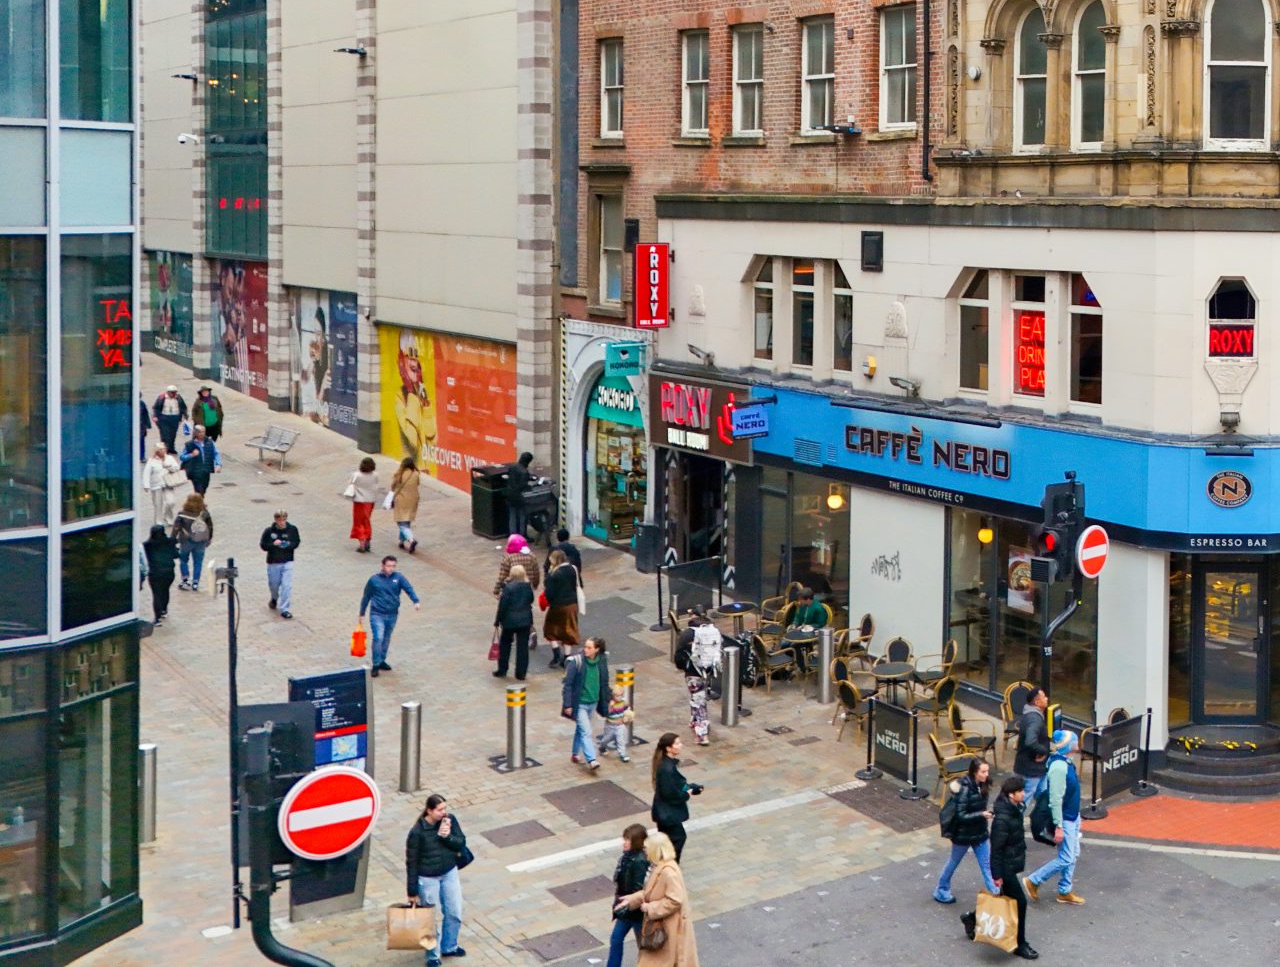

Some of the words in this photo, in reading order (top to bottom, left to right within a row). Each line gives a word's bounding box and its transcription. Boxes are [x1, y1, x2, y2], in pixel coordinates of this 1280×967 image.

[650, 253, 659, 318] ROXY
[1020, 316, 1045, 341] EA
[1210, 329, 1254, 353] ROXY
[609, 361, 639, 371] KOKORO
[598, 385, 635, 412] KOKORO
[661, 381, 712, 430] ROXY
[736, 420, 766, 431] NERO
[421, 443, 462, 471] DISCOVER
[933, 440, 1011, 480] NERO
[889, 480, 900, 490] THE
[902, 483, 926, 496] ITALIAN
[928, 488, 952, 501] COFFEE
[1221, 481, 1238, 496] N
[1190, 538, 1243, 547] ESPRESSO
[1247, 538, 1267, 547] BAR
[876, 732, 907, 755] NERO
[1103, 748, 1138, 773] NERO
